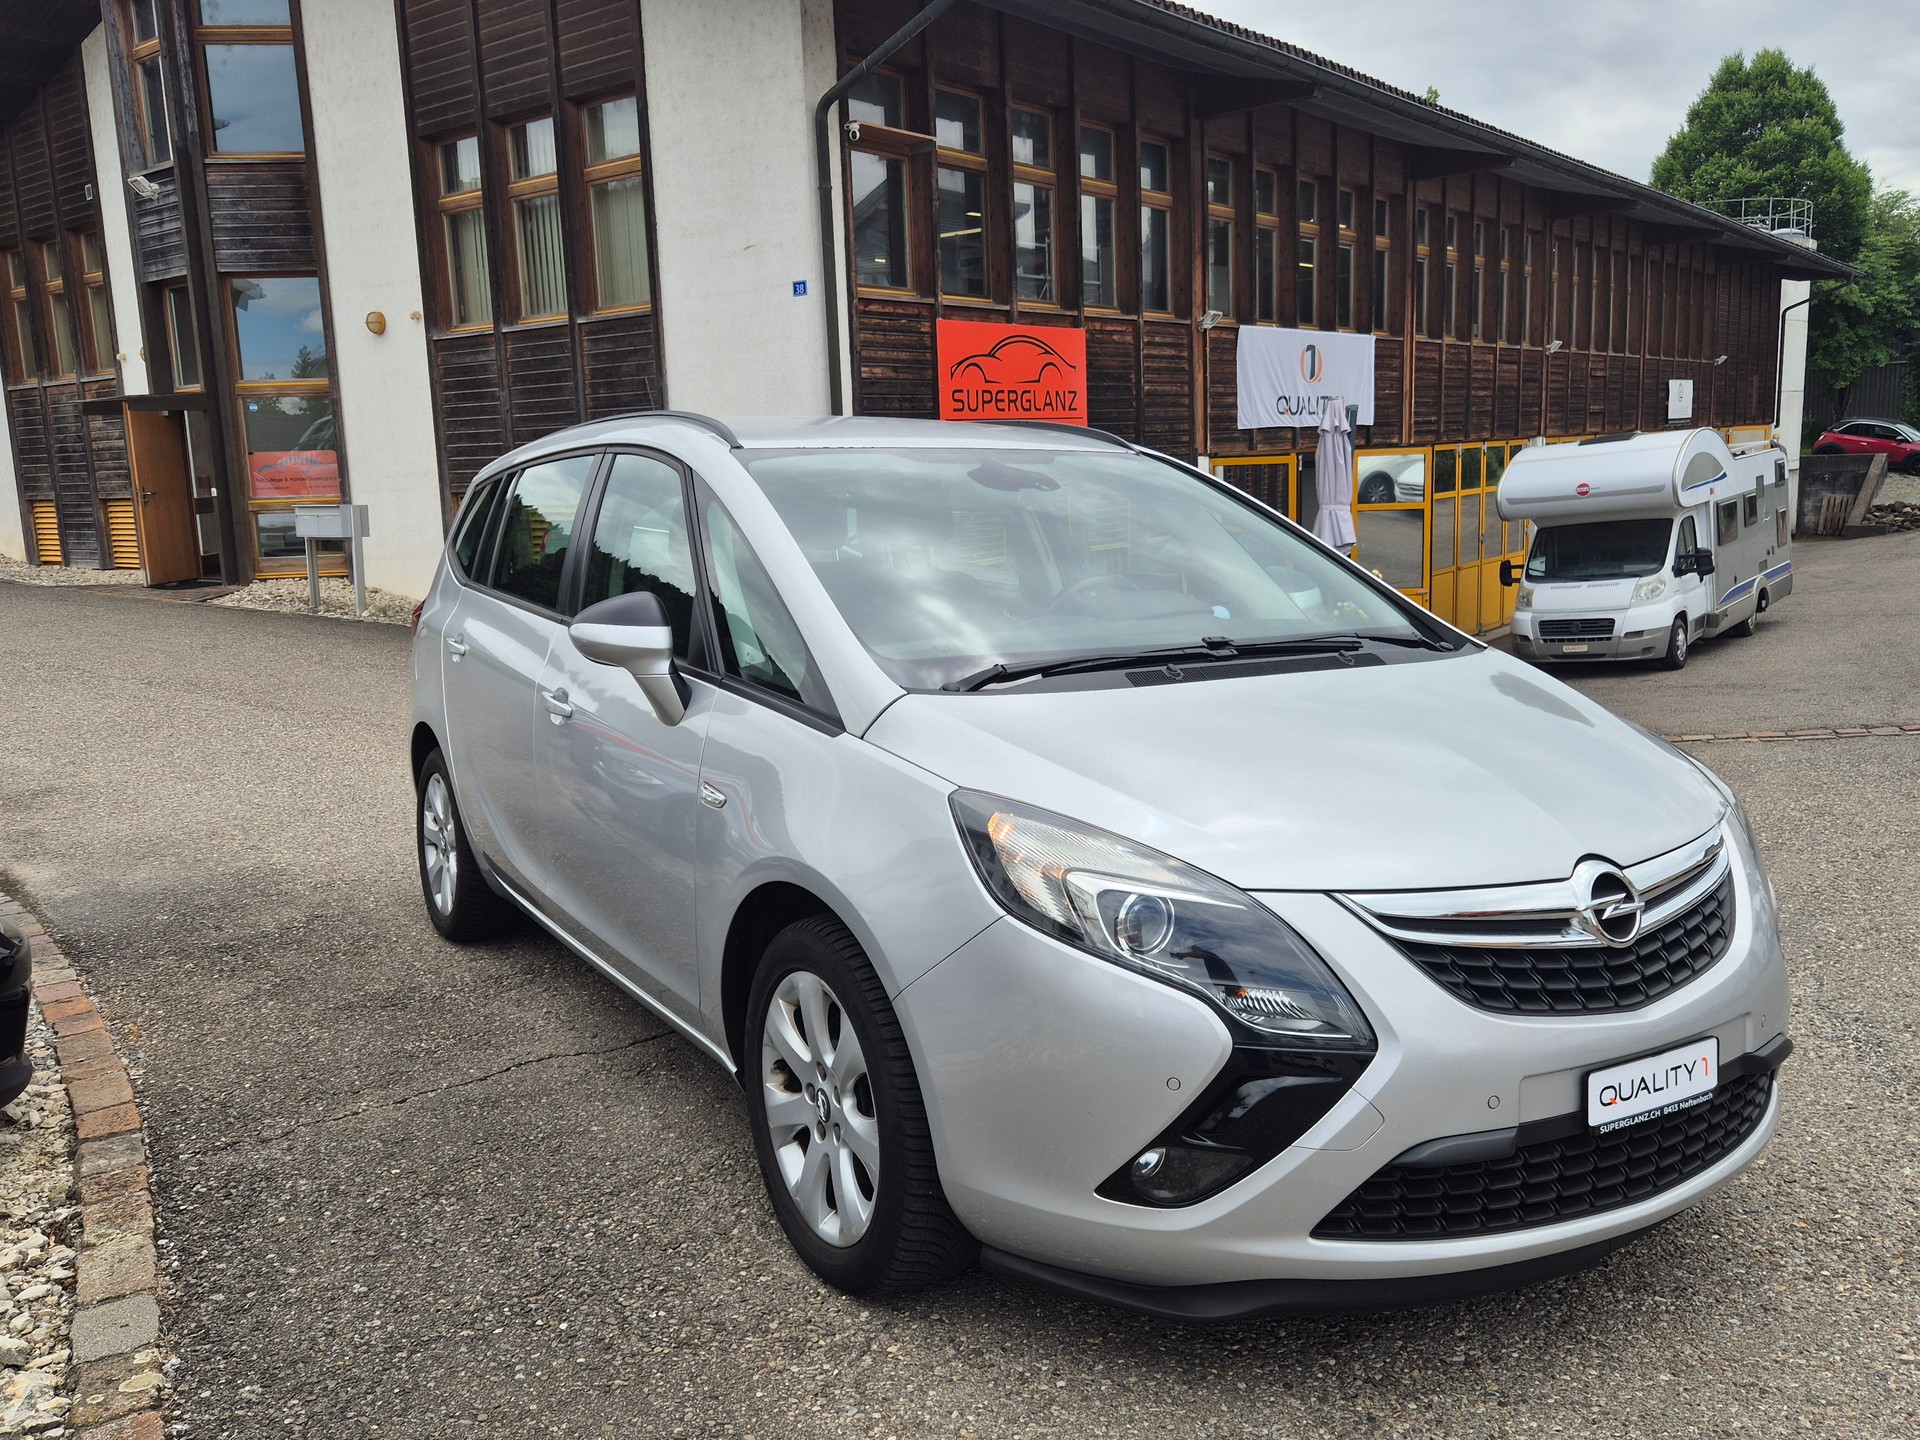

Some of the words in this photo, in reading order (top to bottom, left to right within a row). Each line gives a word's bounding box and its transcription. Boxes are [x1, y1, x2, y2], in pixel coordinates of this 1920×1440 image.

[795, 283, 805, 295] 38
[951, 389, 1078, 413] SUPERGLANZ
[1276, 395, 1339, 416] QUALIT
[1599, 1059, 1697, 1107] QUALITY
[1701, 1056, 1709, 1077] 1
[1599, 1109, 1661, 1134] SUPERGLANZ.CH
[1663, 1103, 1679, 1115] 8413
[1679, 1092, 1713, 1110] Neftenbach
